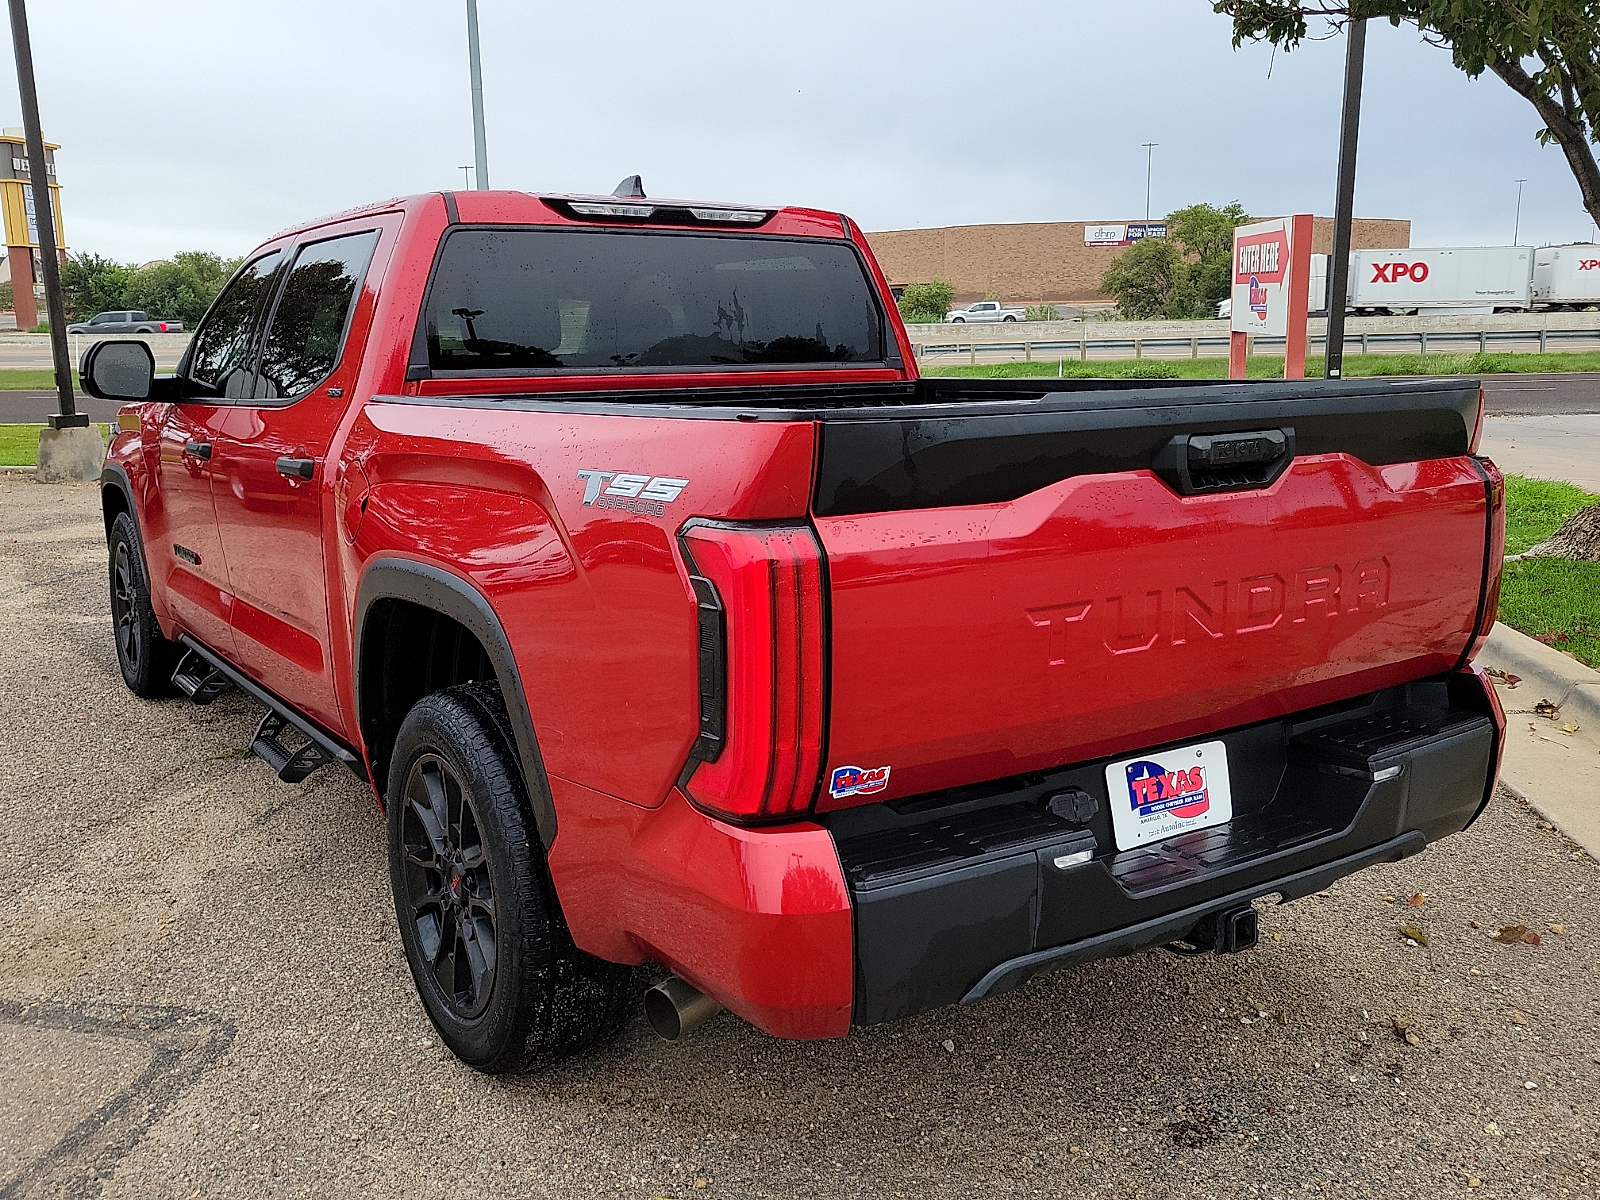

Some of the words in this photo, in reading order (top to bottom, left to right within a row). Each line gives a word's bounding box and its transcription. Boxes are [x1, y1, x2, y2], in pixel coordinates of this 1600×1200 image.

[1239, 244, 1260, 275] ENTER
[1260, 241, 1280, 274] HERE
[1370, 261, 1430, 284] XPO
[1024, 555, 1392, 666] TUNDRA
[835, 768, 886, 789] TEXAS
[1131, 766, 1203, 805] TEXAS
